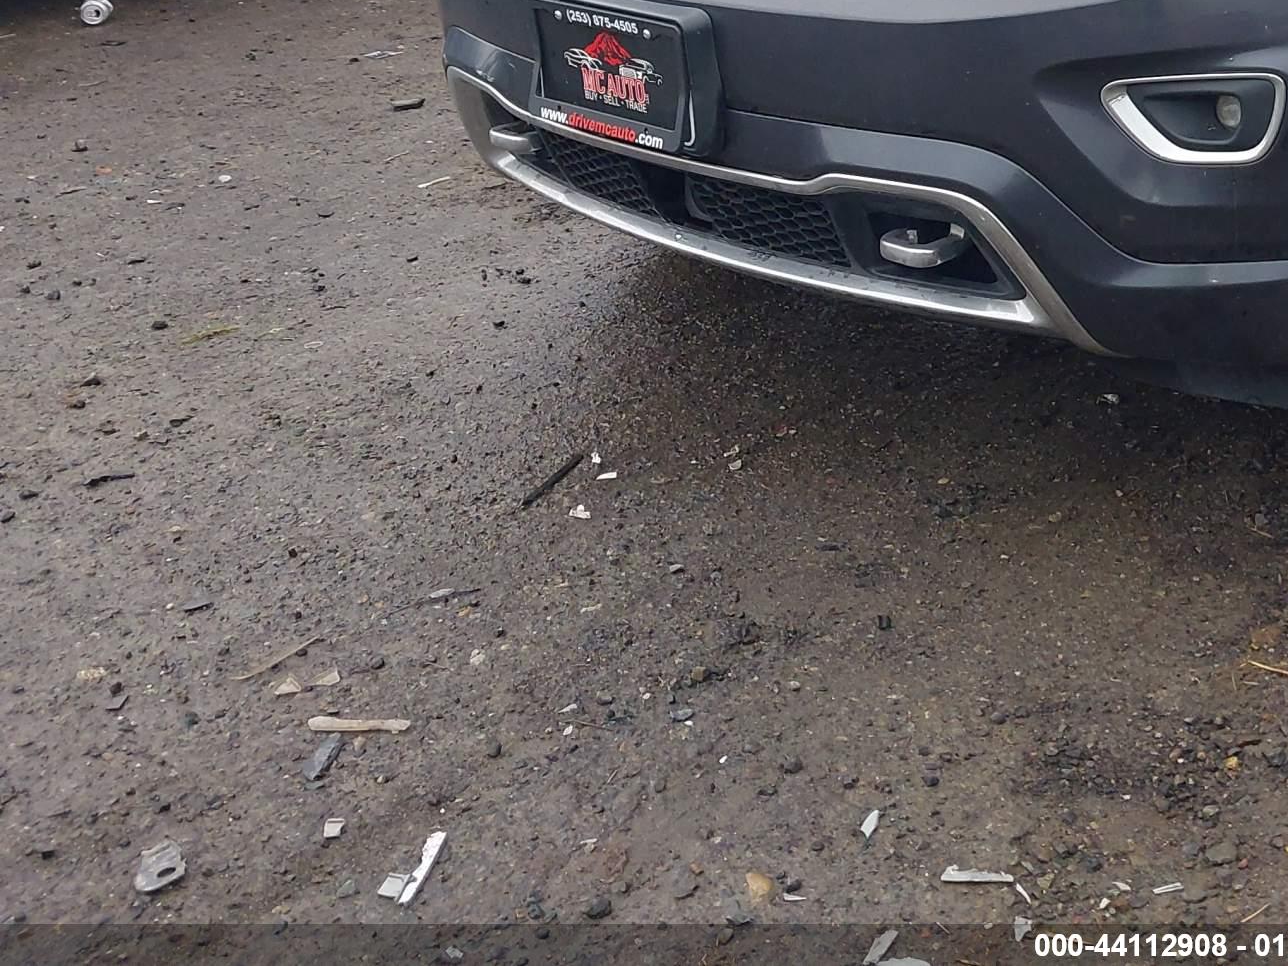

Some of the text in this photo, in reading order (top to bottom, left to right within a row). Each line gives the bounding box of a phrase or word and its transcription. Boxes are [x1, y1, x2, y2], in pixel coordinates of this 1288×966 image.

[567, 9, 592, 26] (253)
[581, 67, 606, 94] MC
[606, 73, 646, 104] AUTO
[584, 90, 598, 101] BUY
[603, 94, 621, 107] SELL
[625, 99, 648, 114] TRADE
[540, 105, 664, 150] www.drivemcauto.com
